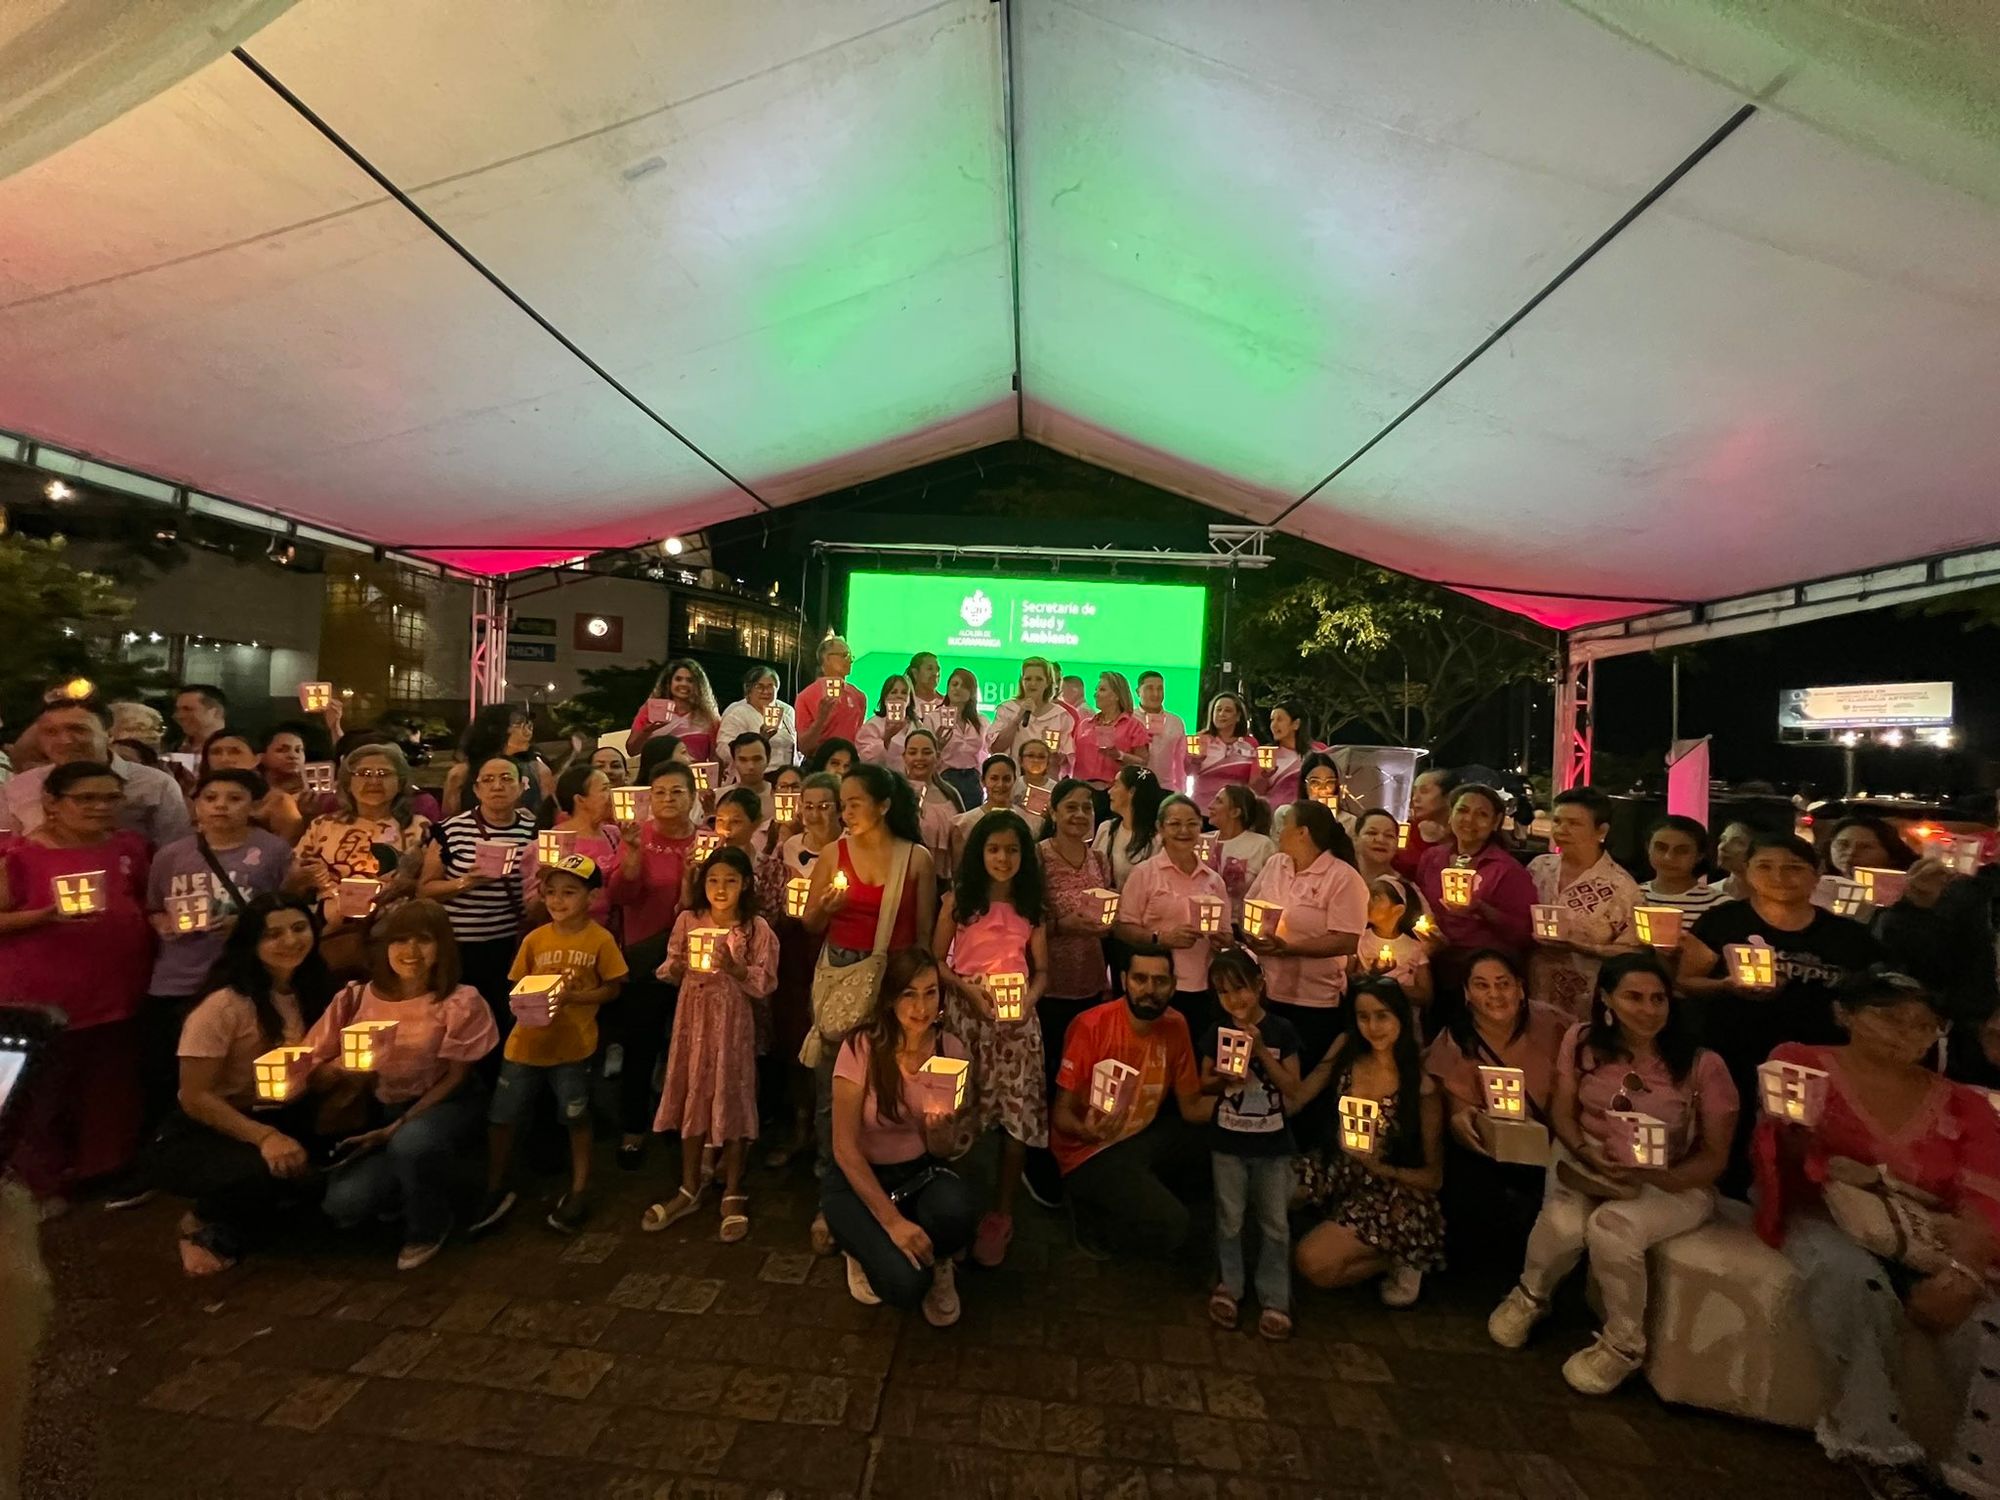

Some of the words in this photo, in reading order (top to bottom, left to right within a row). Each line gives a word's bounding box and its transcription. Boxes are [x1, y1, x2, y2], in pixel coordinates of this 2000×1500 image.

[1081, 602, 1096, 615] de
[1022, 614, 1055, 629] Salud
[1056, 618, 1064, 632] y
[1021, 630, 1079, 645] Ambiente
[534, 950, 563, 966] WILD
[567, 949, 596, 967] TRIP
[1775, 960, 1841, 988] appy
